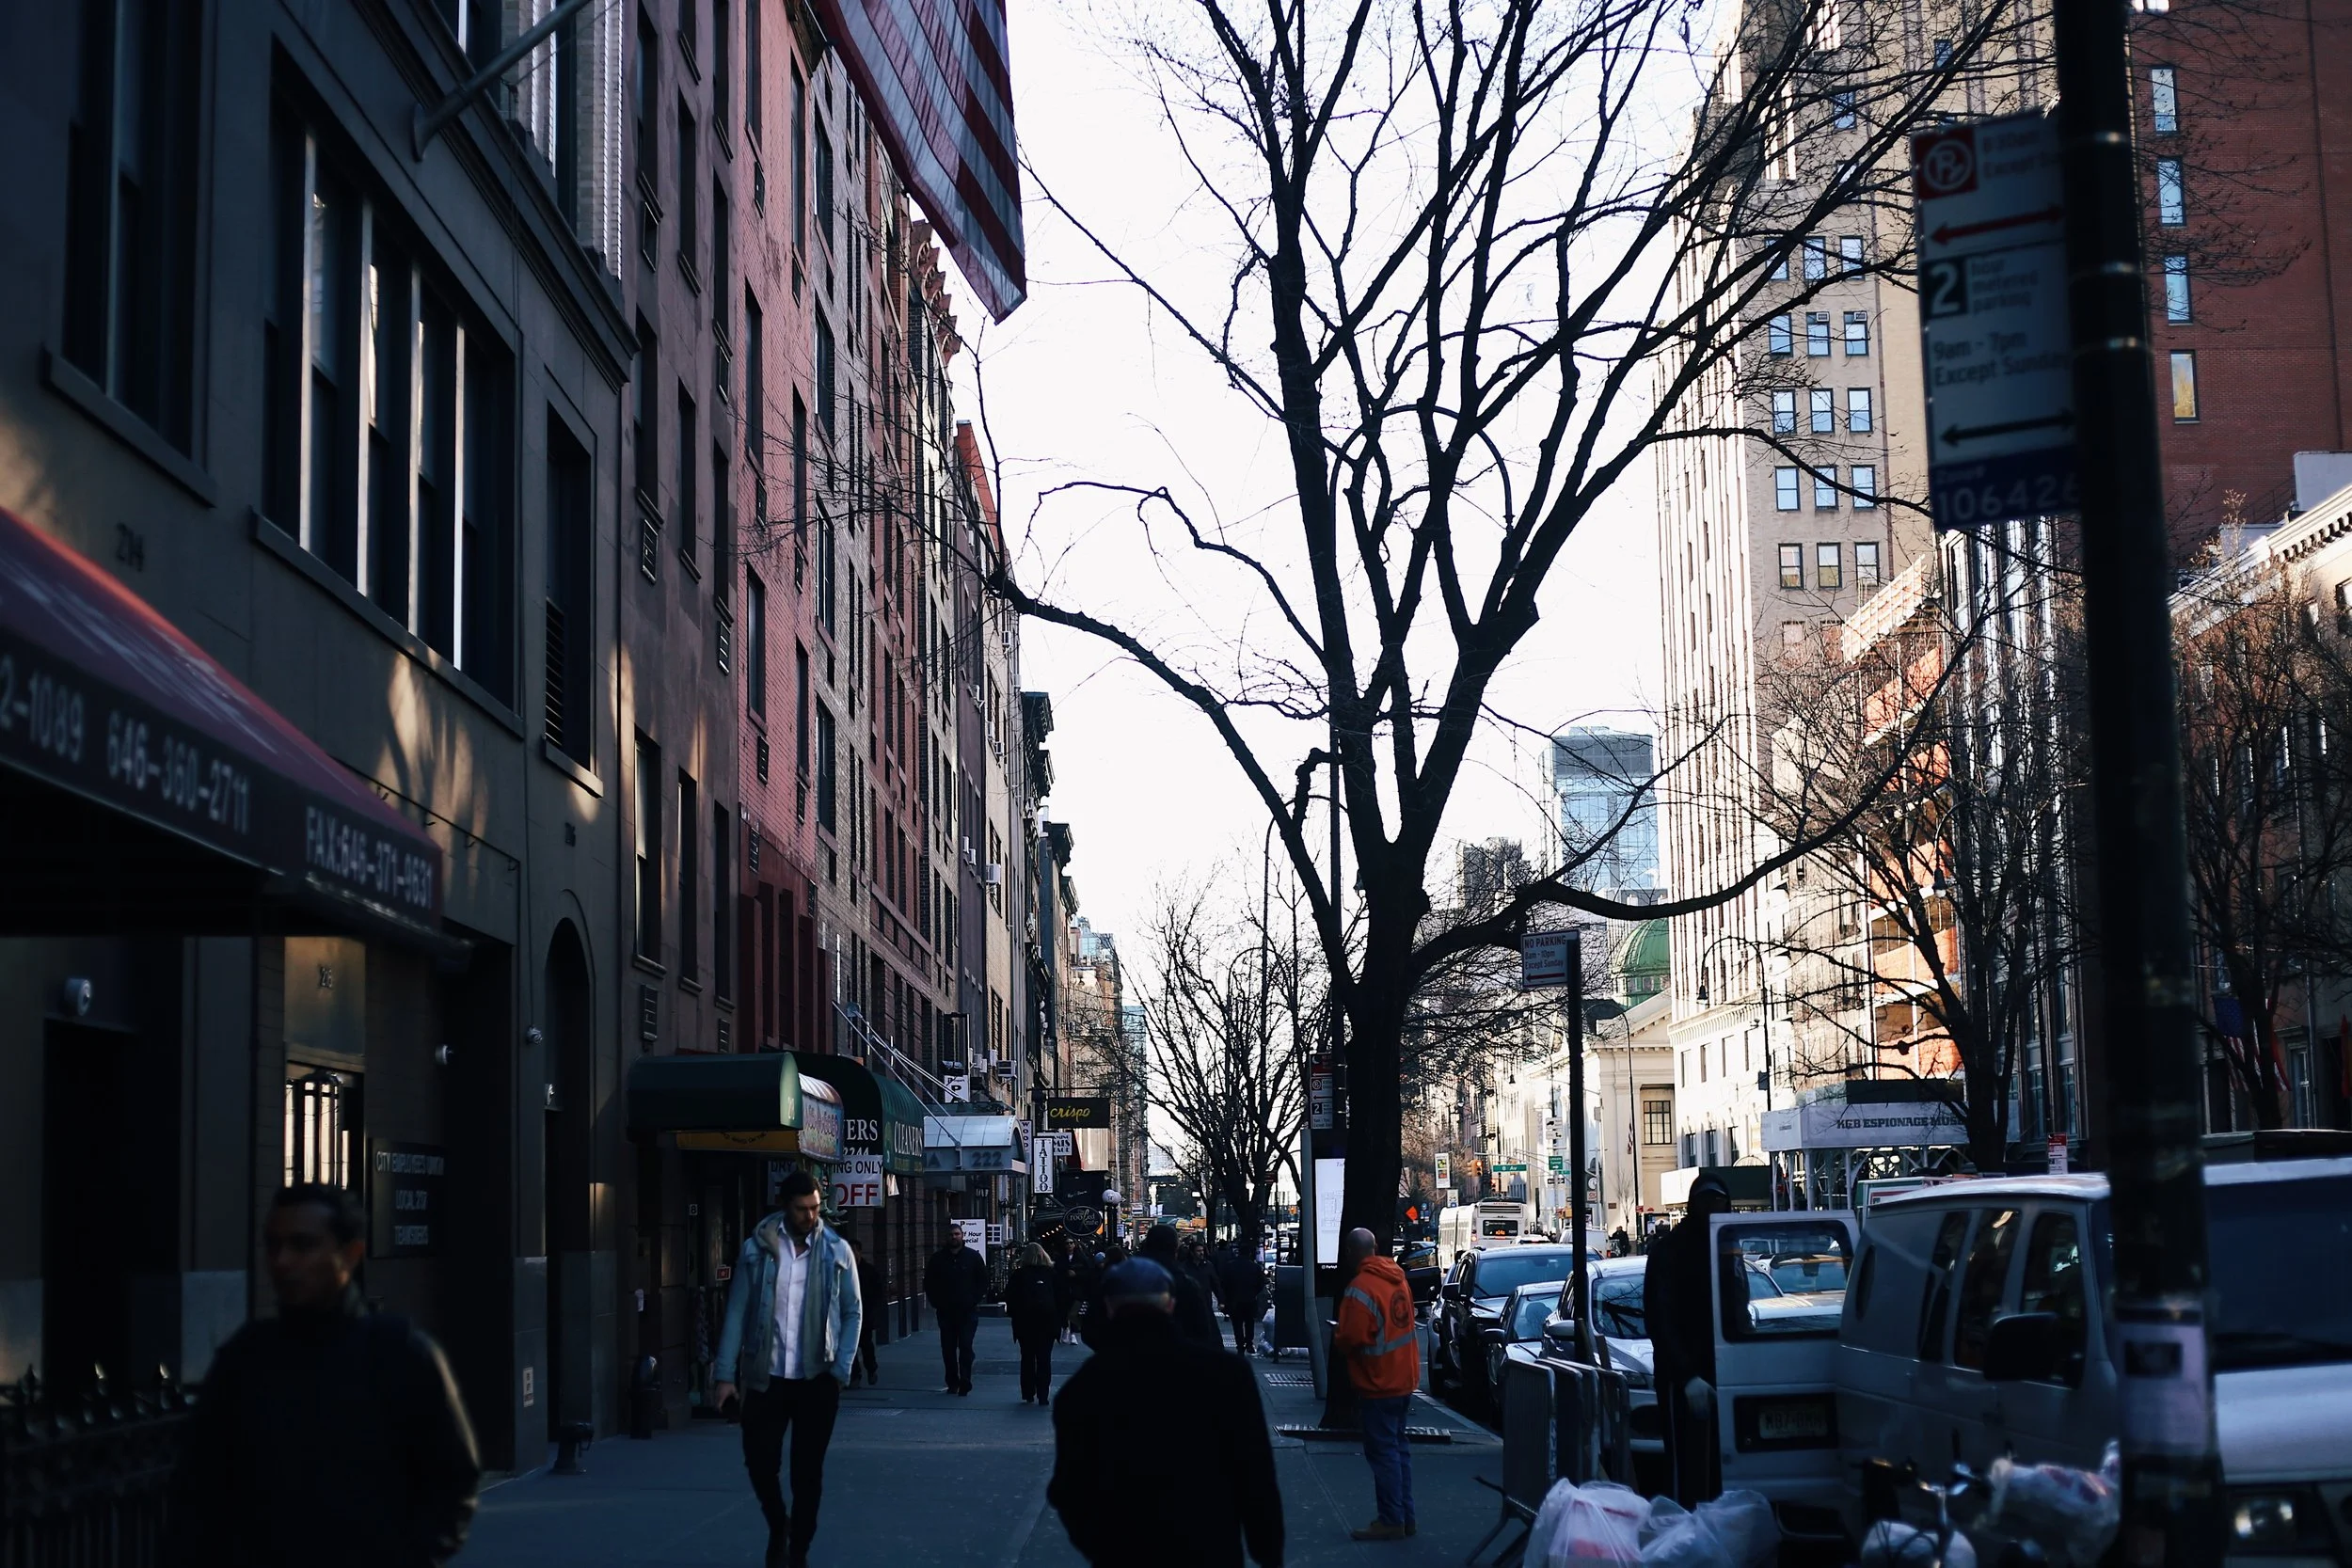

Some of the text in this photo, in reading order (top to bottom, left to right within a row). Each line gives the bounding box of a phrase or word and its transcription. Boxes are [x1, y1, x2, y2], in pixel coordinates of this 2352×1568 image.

[1930, 261, 1962, 315] 2
[1934, 360, 1996, 387] Except
[1524, 935, 1566, 949] NO PARKING
[1050, 1105, 1091, 1123] crispo
[1836, 1119, 1861, 1130] KGB
[1863, 1117, 1929, 1129] ESPIONAGE
[844, 1118, 878, 1142] ERS
[894, 1120, 923, 1157] CLEANERS
[771, 1159, 794, 1172] DRY
[855, 1161, 883, 1175] ONLY
[971, 1150, 1004, 1167] 222
[1039, 1139, 1049, 1192] TATTOO
[833, 1182, 879, 1206] OFF
